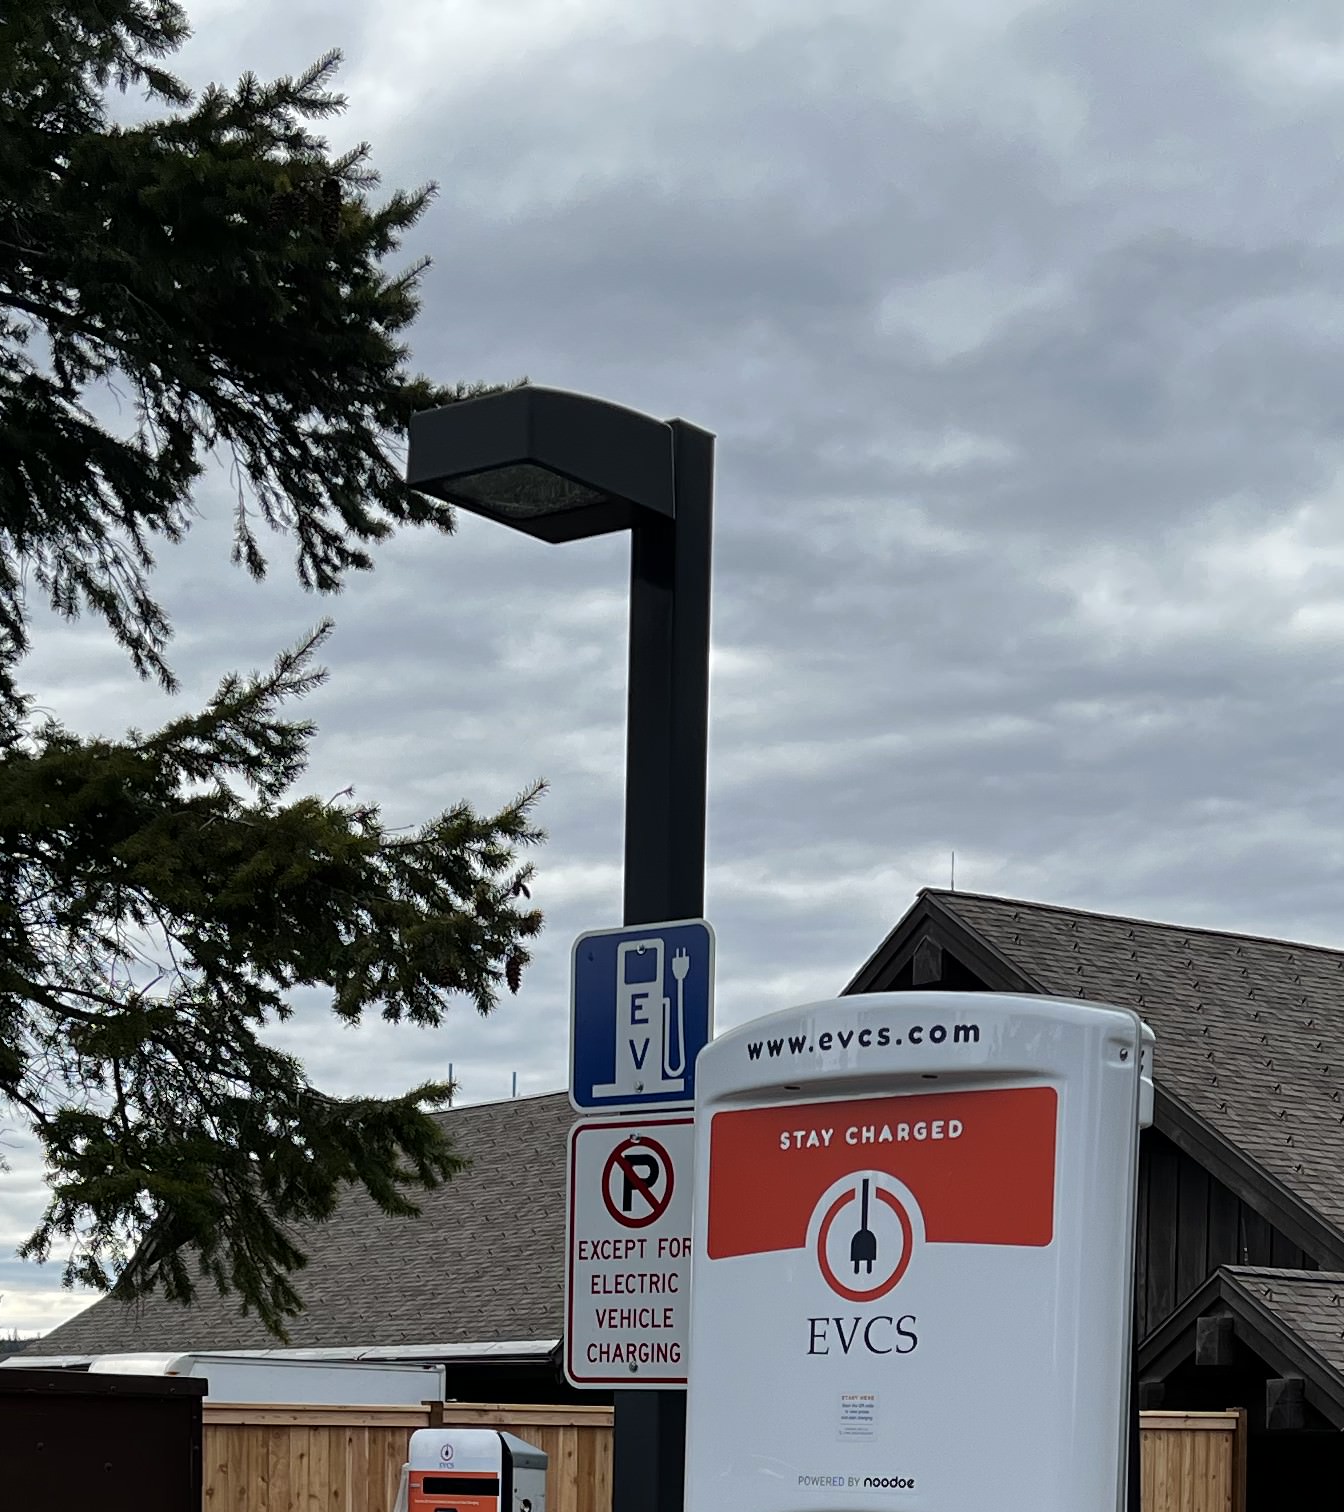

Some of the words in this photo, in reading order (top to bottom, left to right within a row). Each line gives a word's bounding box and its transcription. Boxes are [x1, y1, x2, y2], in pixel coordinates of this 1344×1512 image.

[746, 1023, 981, 1062] www.evcs.com
[778, 1128, 836, 1151] STAY
[845, 1119, 965, 1146] CHARGED
[578, 1239, 646, 1261] EXCEPT
[590, 1273, 679, 1295] ELECTRIC
[594, 1307, 675, 1330] VEHICLE
[805, 1313, 919, 1356] EVCS
[586, 1343, 681, 1365] CHARGING
[798, 1475, 845, 1488] POWERED
[847, 1476, 861, 1488] BY
[863, 1475, 915, 1489] noodoe
